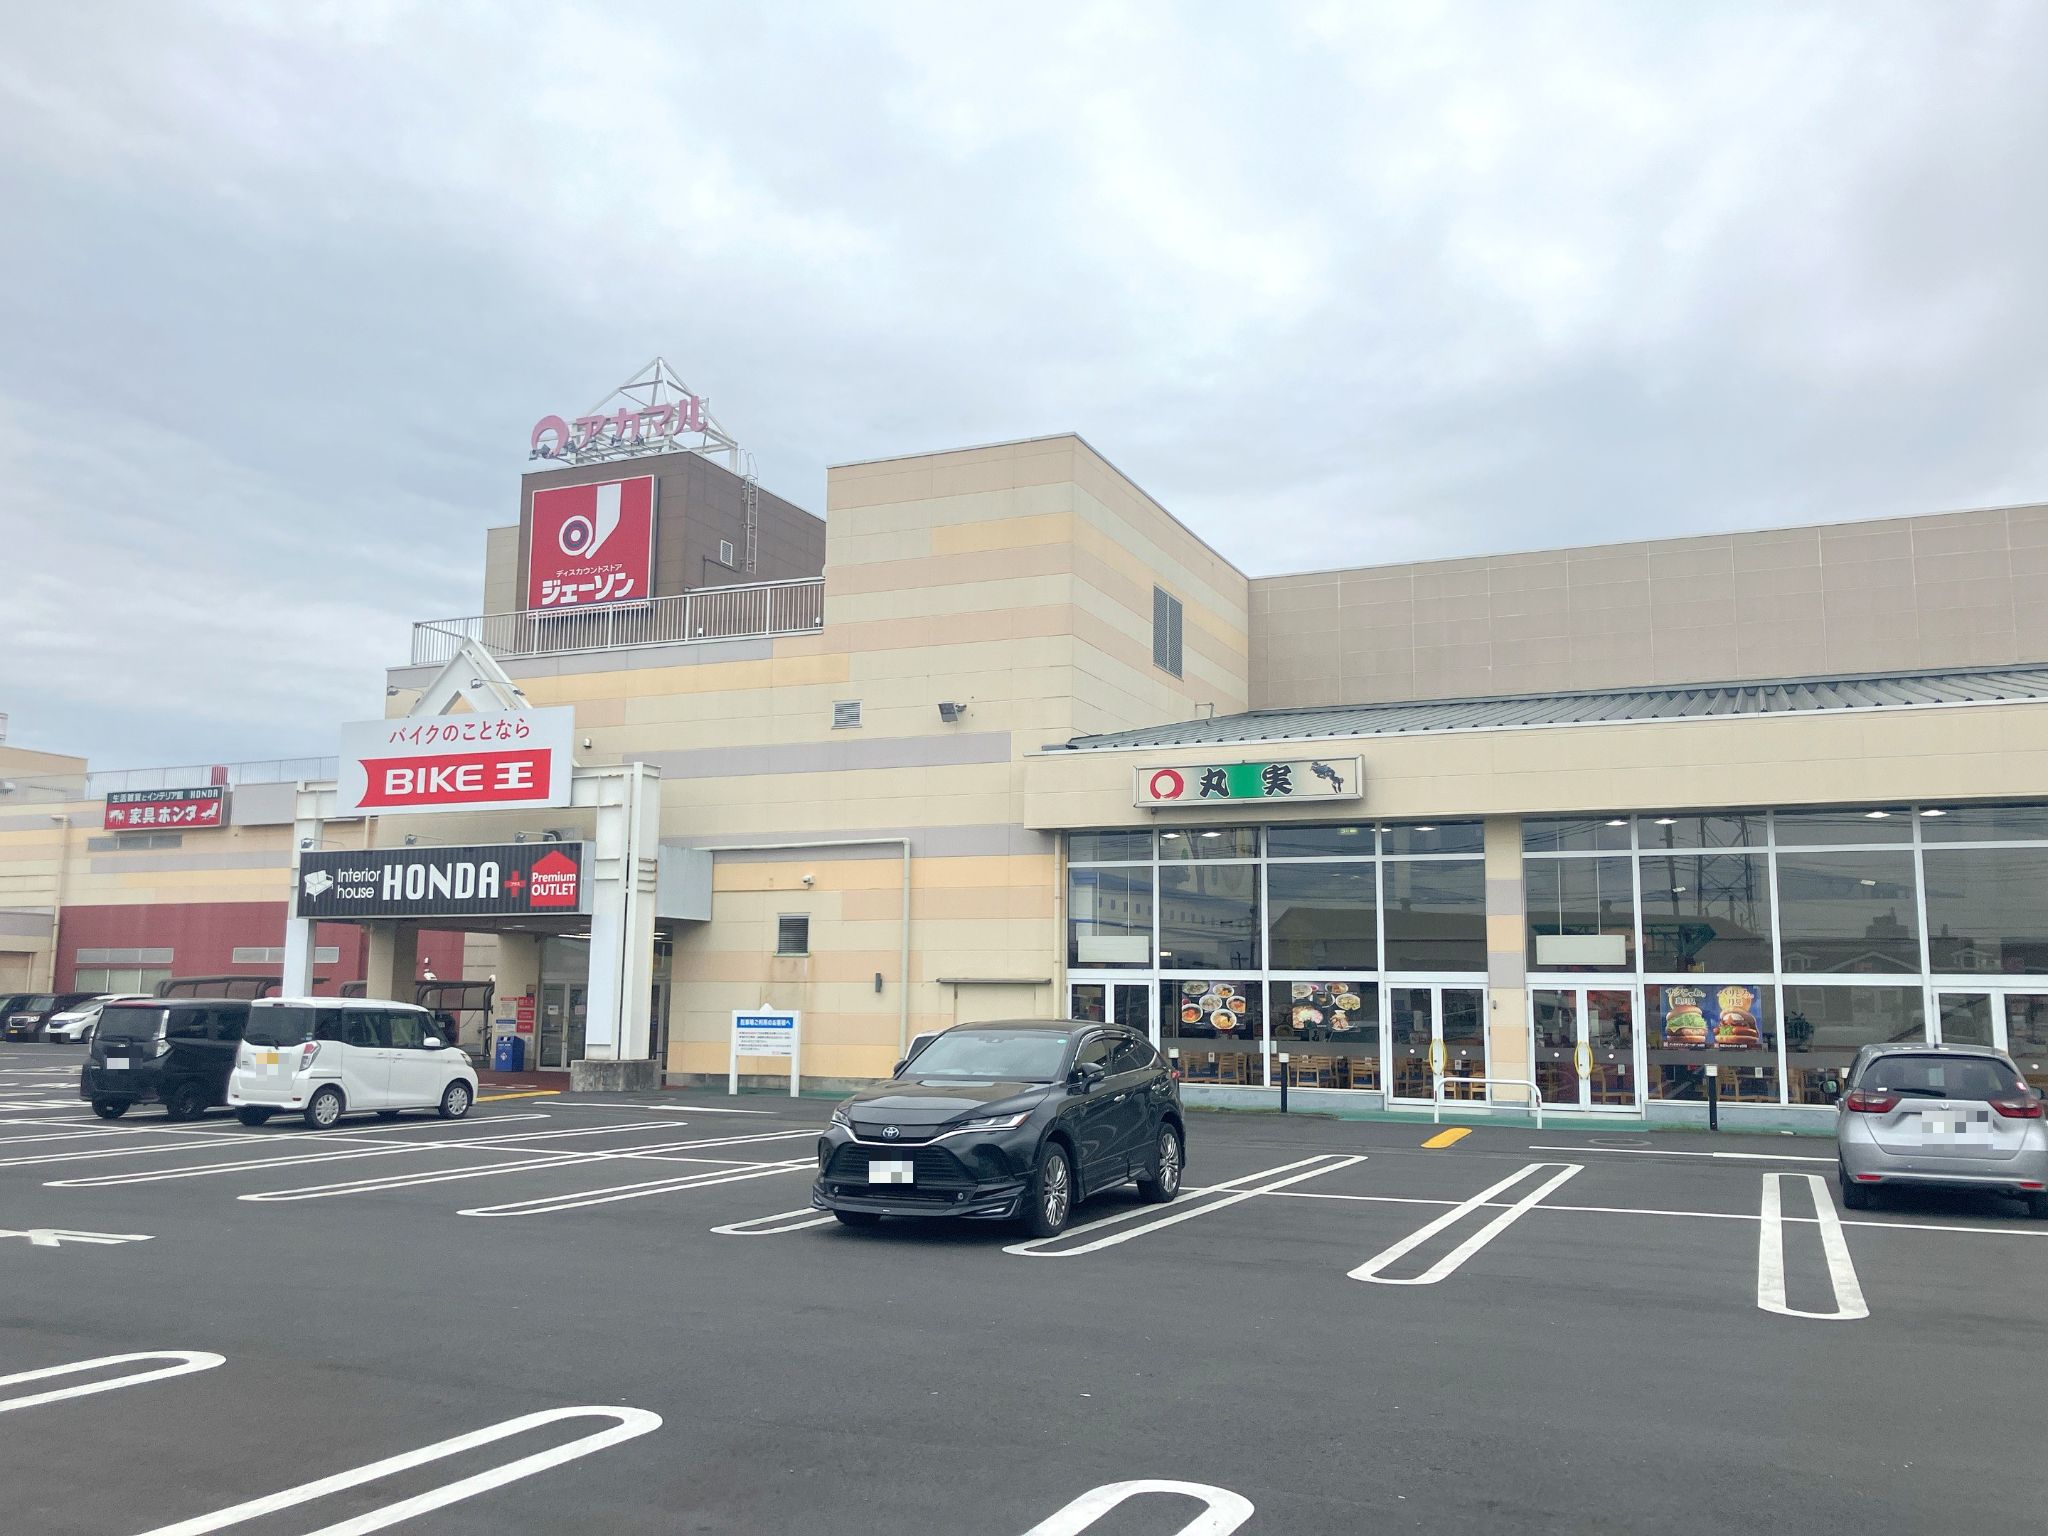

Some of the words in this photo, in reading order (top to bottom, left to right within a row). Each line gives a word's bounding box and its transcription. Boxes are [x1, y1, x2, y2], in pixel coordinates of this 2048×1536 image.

[576, 396, 708, 449] アカマル
[556, 563, 623, 578] ディスカウントストア
[541, 572, 635, 605] ジェーソン
[389, 718, 531, 745] バイクのことなら
[385, 764, 484, 796] BIKE
[494, 761, 534, 790] 王
[190, 789, 219, 799] HONDA
[129, 804, 198, 825] 家具ホンダ
[337, 867, 381, 883] Interior
[382, 861, 499, 900] HONDA
[532, 872, 577, 883] Premium
[337, 884, 375, 899] house
[531, 883, 576, 896] OUTLET
